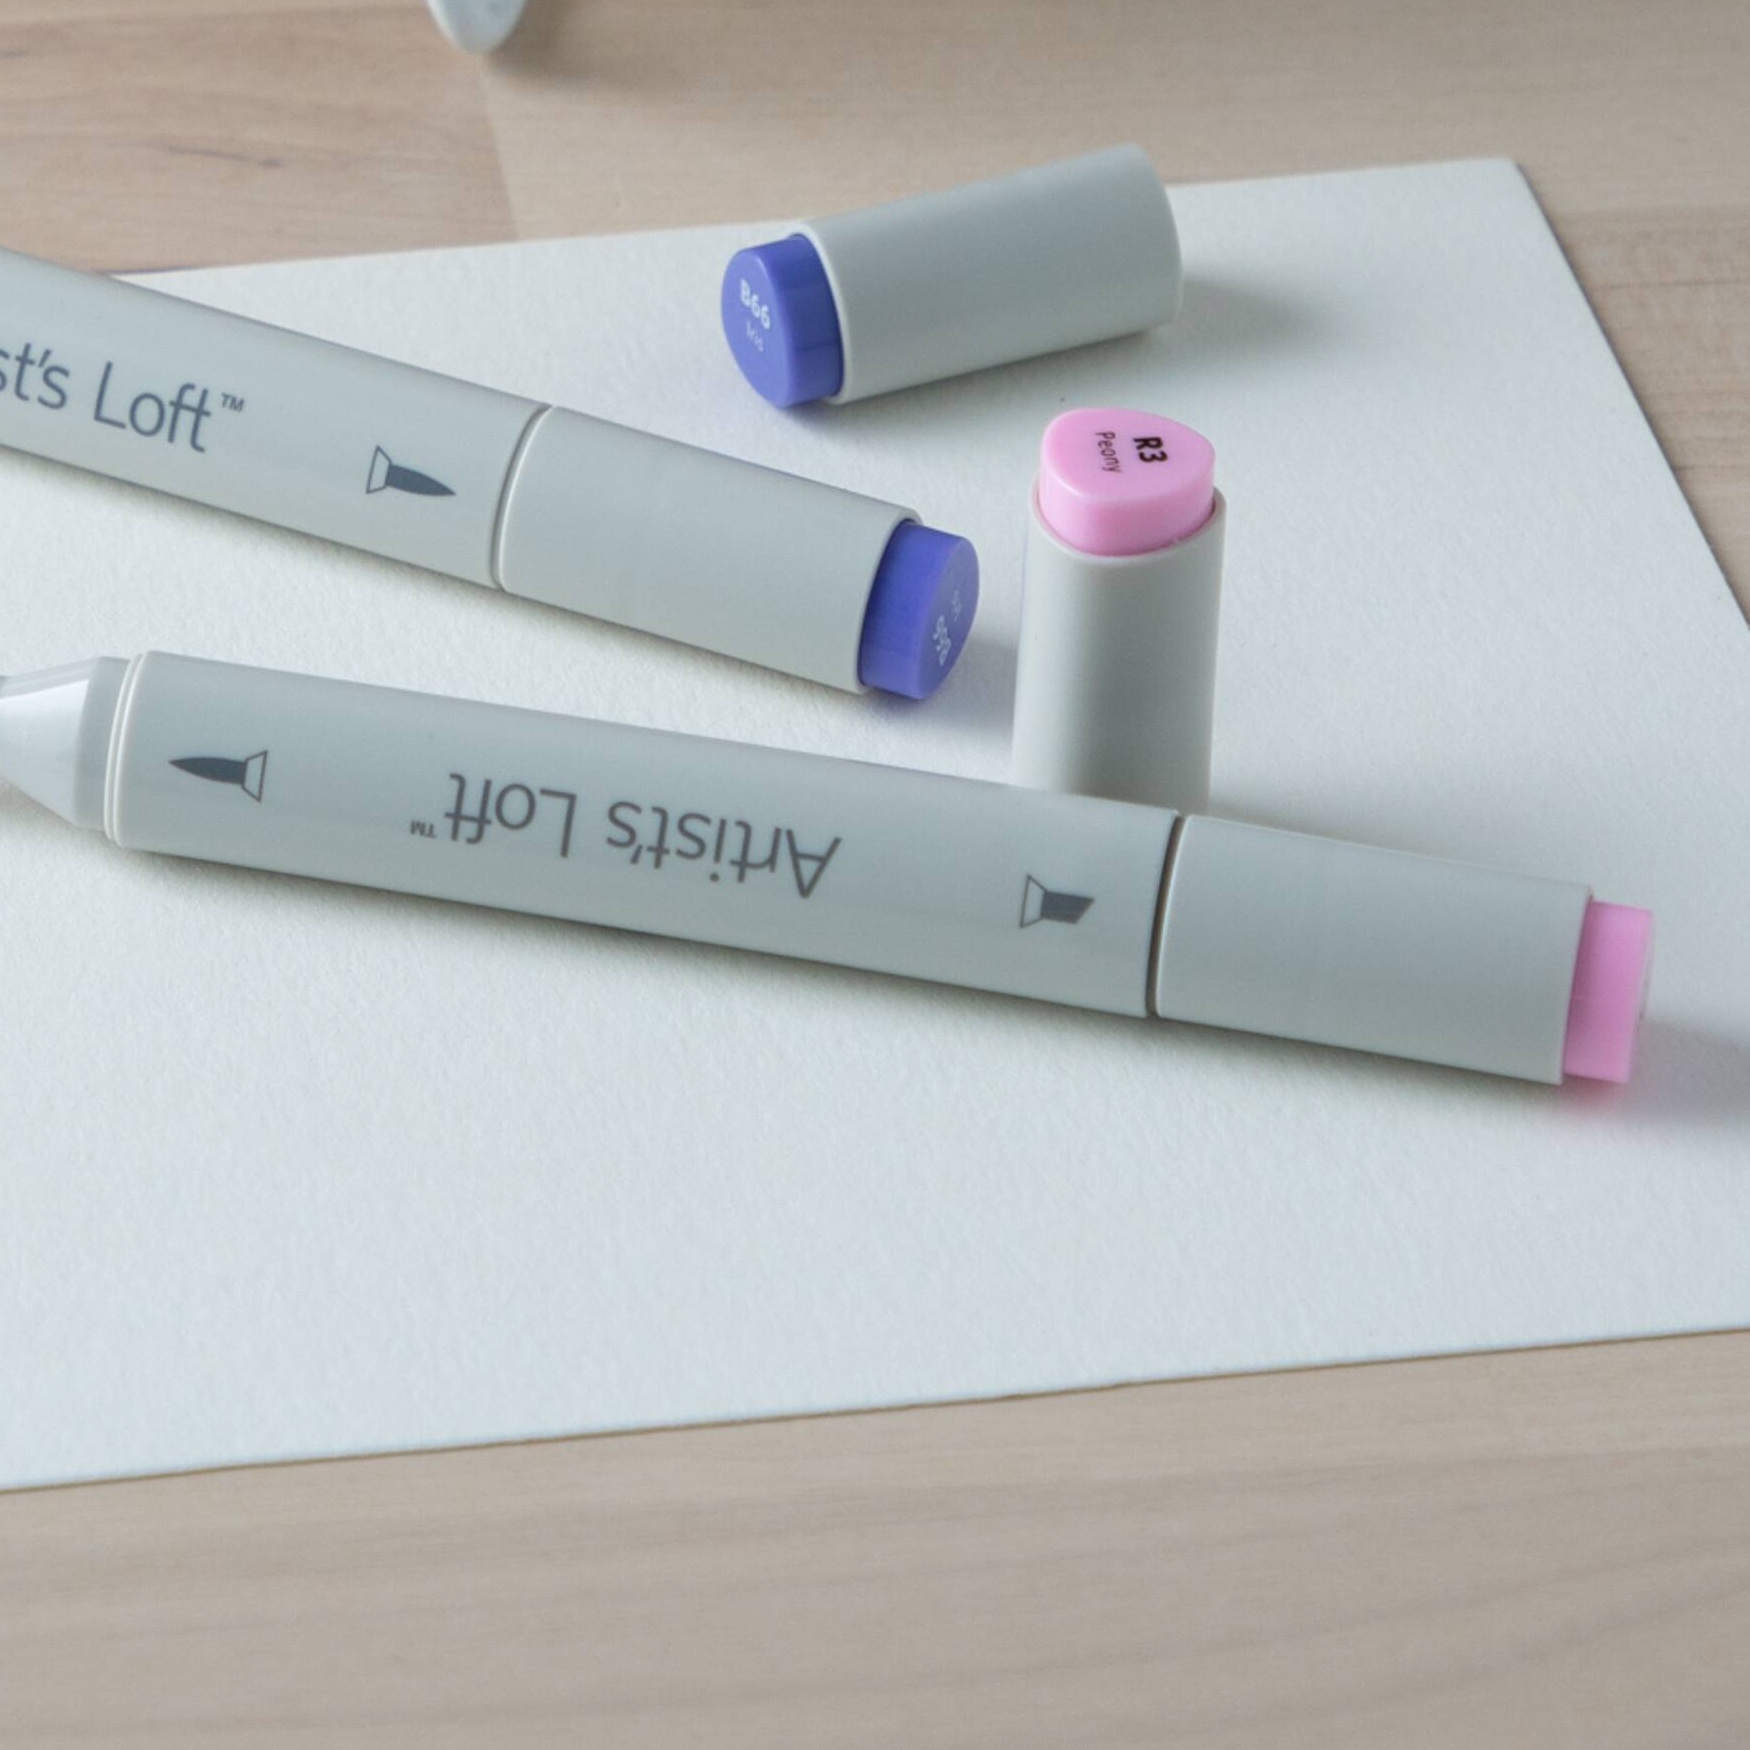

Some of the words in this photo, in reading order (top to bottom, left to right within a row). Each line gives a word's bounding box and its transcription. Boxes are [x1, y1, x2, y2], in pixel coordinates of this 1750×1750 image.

[1095, 431, 1123, 473] Peony
[1132, 436, 1169, 464] R3
[606, 800, 843, 899] Artist's
